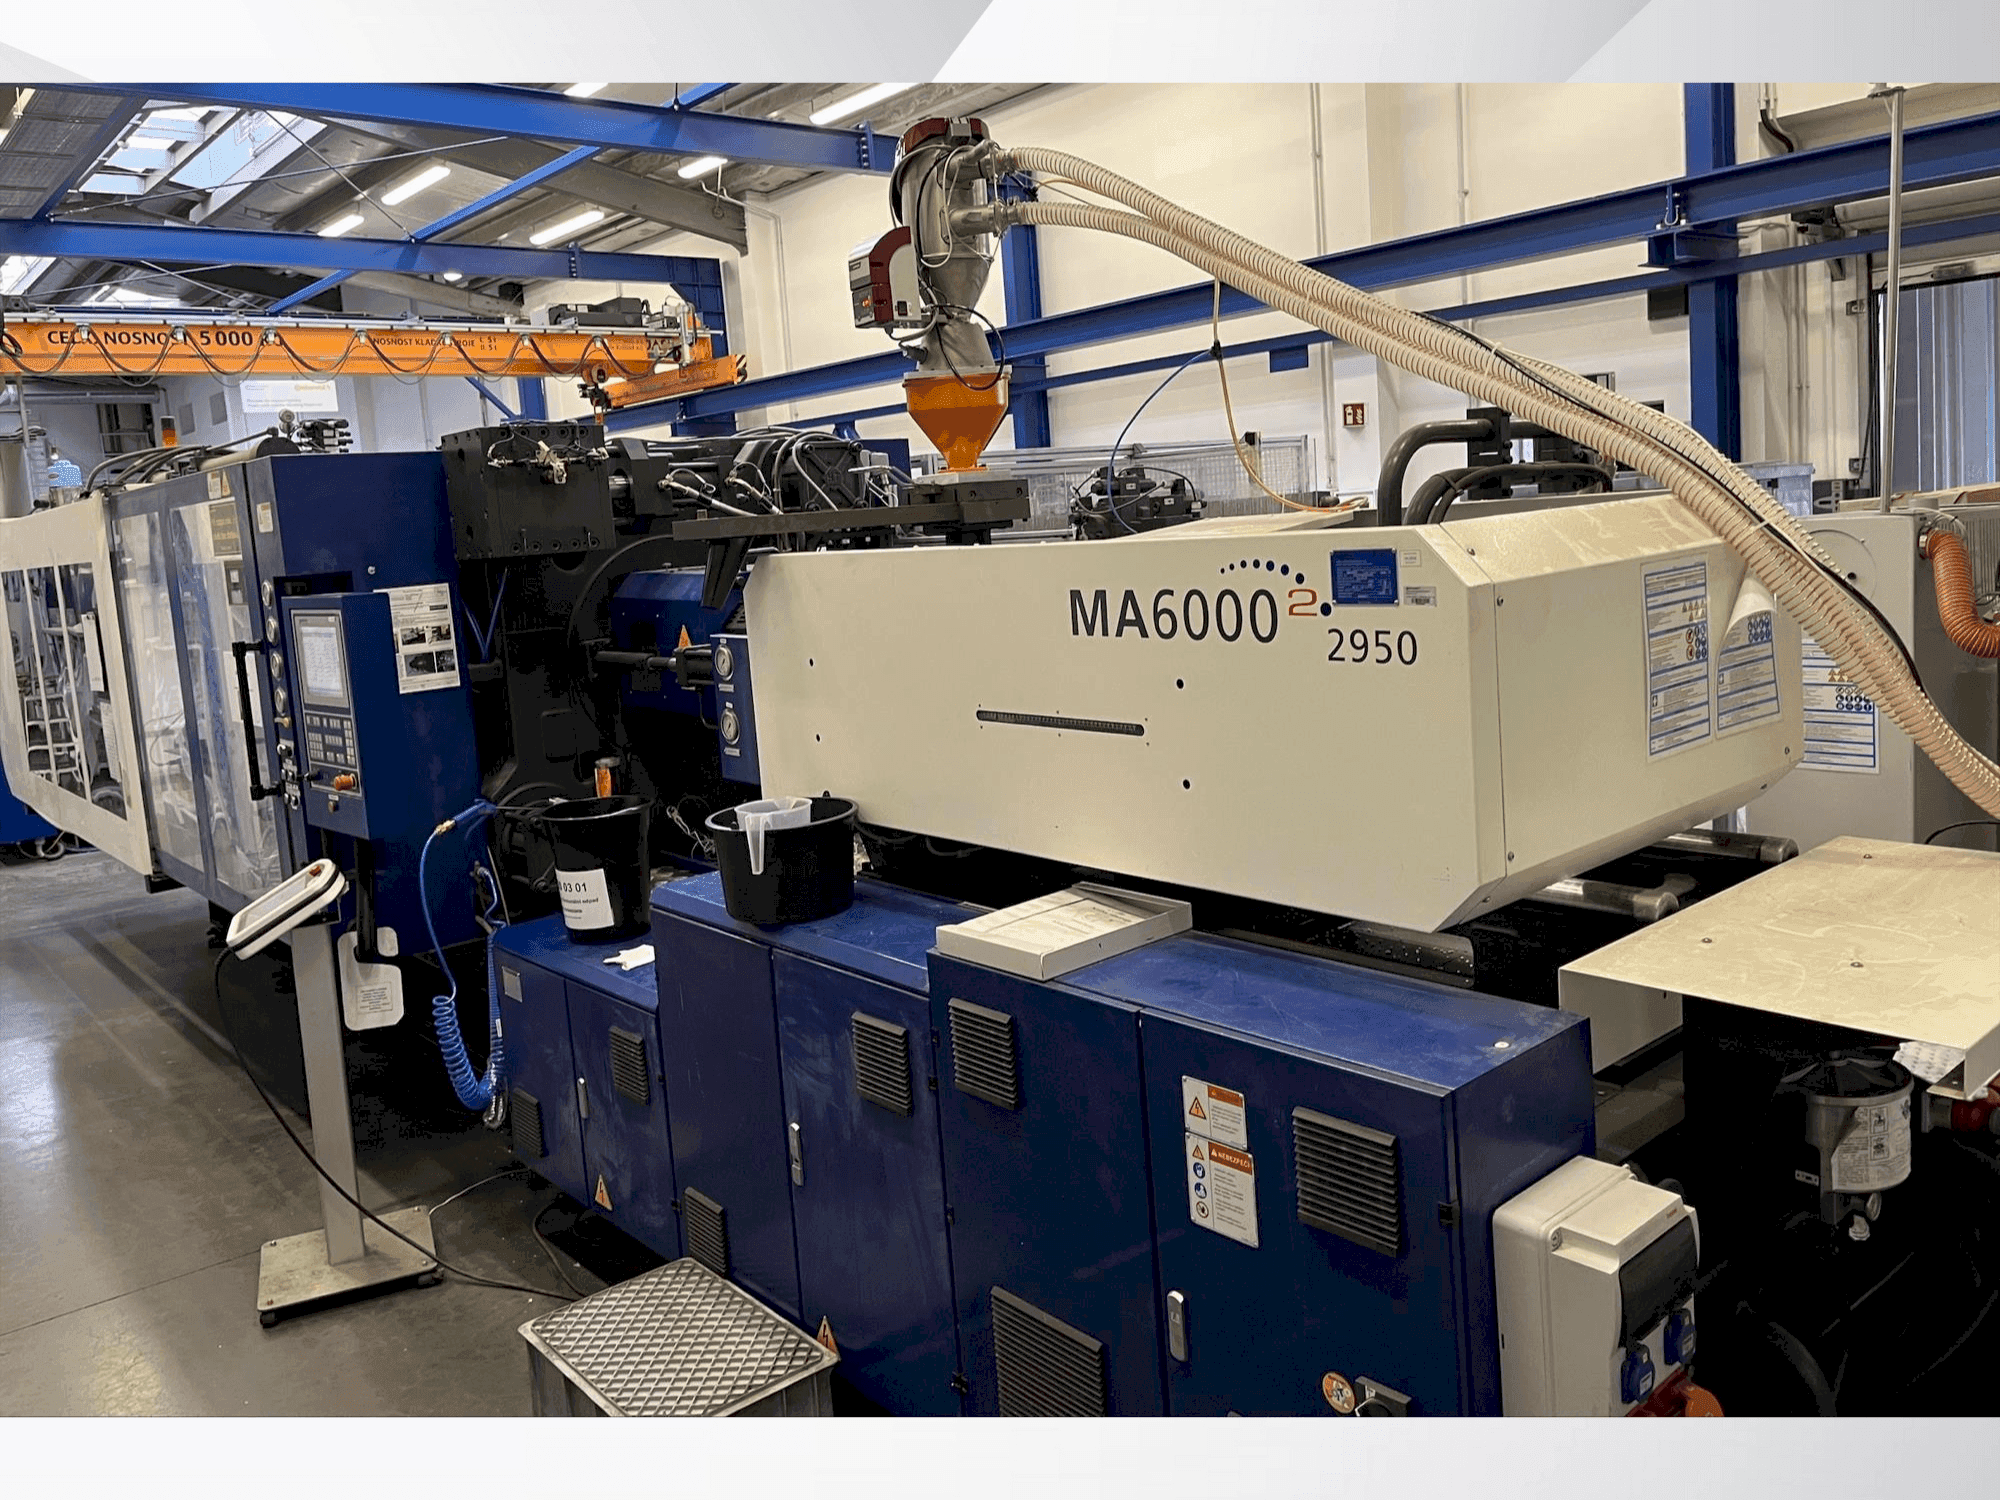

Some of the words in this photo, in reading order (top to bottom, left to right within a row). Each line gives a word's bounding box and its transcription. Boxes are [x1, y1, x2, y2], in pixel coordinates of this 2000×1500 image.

[1069, 588, 1278, 643] MA6000
[1287, 588, 1318, 616] 2
[1327, 628, 1418, 666] 2950
